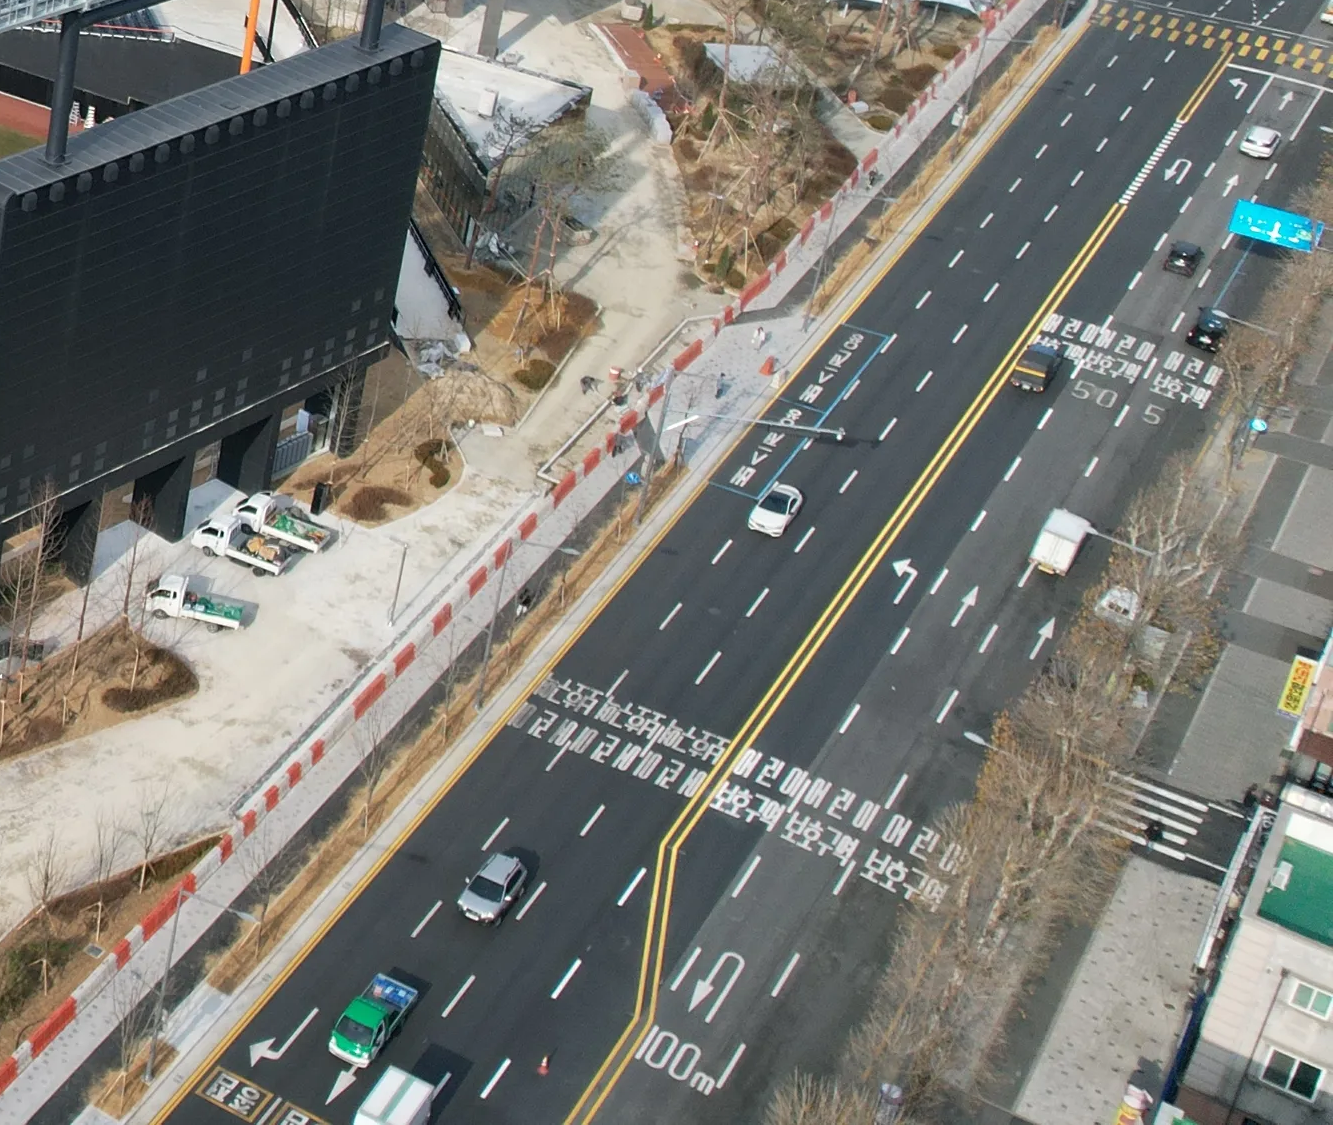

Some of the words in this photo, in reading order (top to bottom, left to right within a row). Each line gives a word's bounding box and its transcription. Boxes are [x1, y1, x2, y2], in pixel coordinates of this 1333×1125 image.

[1041, 313, 1100, 344] 어린이
[1095, 328, 1156, 362] 어린이
[1163, 350, 1224, 386] 어린이
[1082, 348, 1142, 384] 보호구역
[1149, 372, 1213, 409] 보호구역
[1071, 380, 1118, 409] 50
[733, 747, 809, 798] 어린이
[803, 777, 881, 832] 어린이
[710, 780, 786, 832] 보호구역
[780, 811, 860, 867] 보호구역
[860, 848, 949, 913] 보호구역
[205, 1072, 261, 1115] 종점
[634, 1024, 716, 1096] 100m
